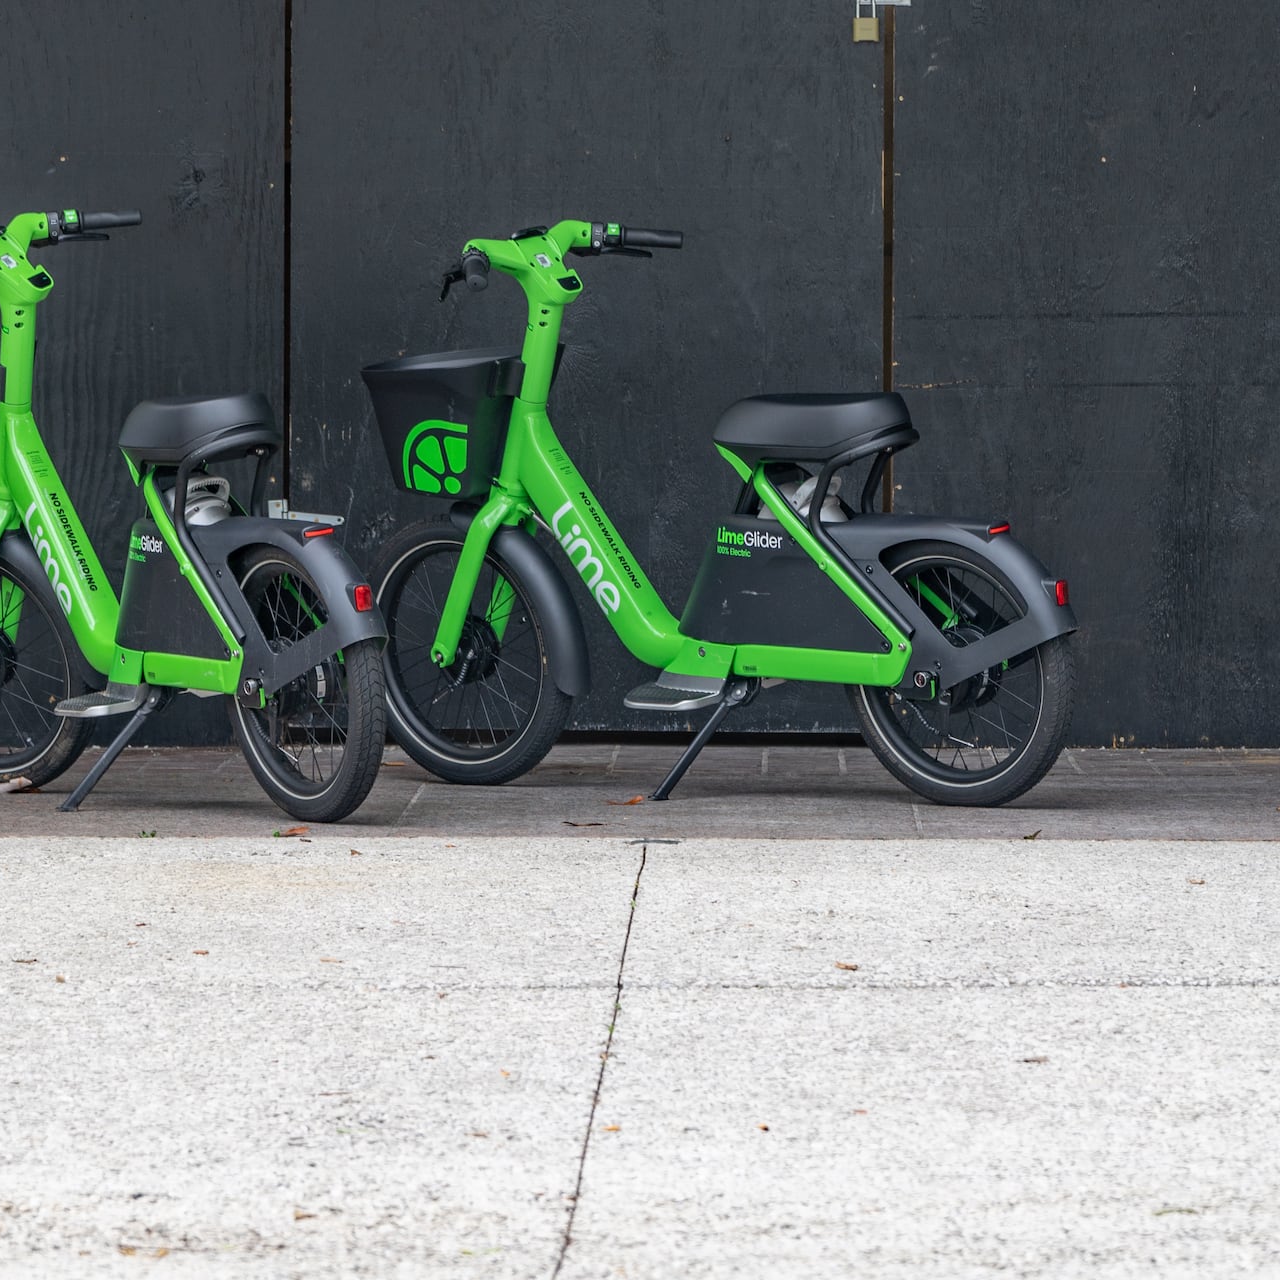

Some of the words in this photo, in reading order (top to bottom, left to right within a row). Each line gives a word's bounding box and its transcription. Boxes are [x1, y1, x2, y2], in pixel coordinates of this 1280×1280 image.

[48, 492, 63, 508] NO
[56, 508, 84, 558] SIDEWALK
[77, 558, 98, 592] RIDING
[551, 499, 621, 617] Lime
[578, 491, 591, 507] NO
[588, 506, 621, 555] SIDEWALK
[617, 555, 642, 589] RIDING
[717, 526, 783, 549] LimeGlider
